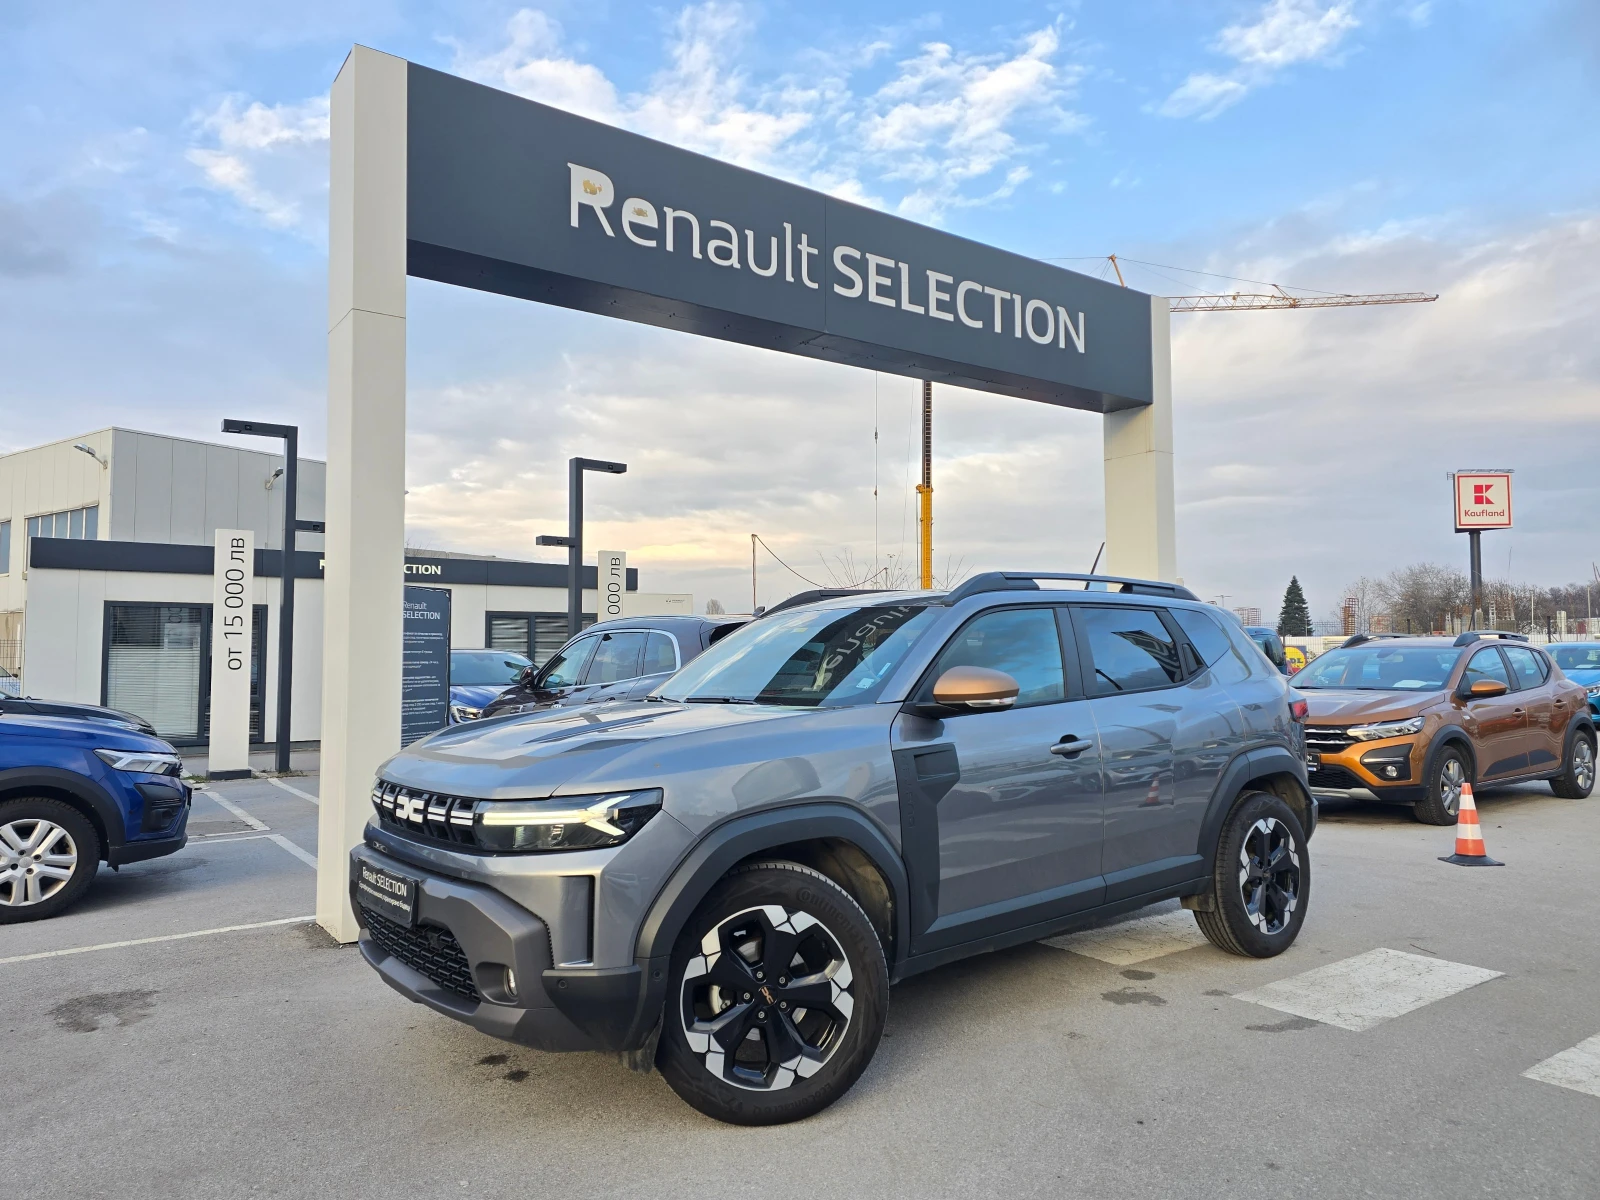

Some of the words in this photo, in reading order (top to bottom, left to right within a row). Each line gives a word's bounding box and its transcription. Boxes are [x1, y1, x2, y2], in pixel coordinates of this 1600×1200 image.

[567, 162, 819, 289] Renault
[833, 245, 1086, 354] SELECTION
[1464, 509, 1505, 517] Kaufland
[404, 564, 441, 575] CTION
[224, 568, 245, 609] 000
[607, 582, 621, 615] 000
[223, 615, 244, 640] 15
[227, 647, 243, 671] от
[362, 866, 377, 885] Renault
[376, 874, 407, 897] SELECTION
